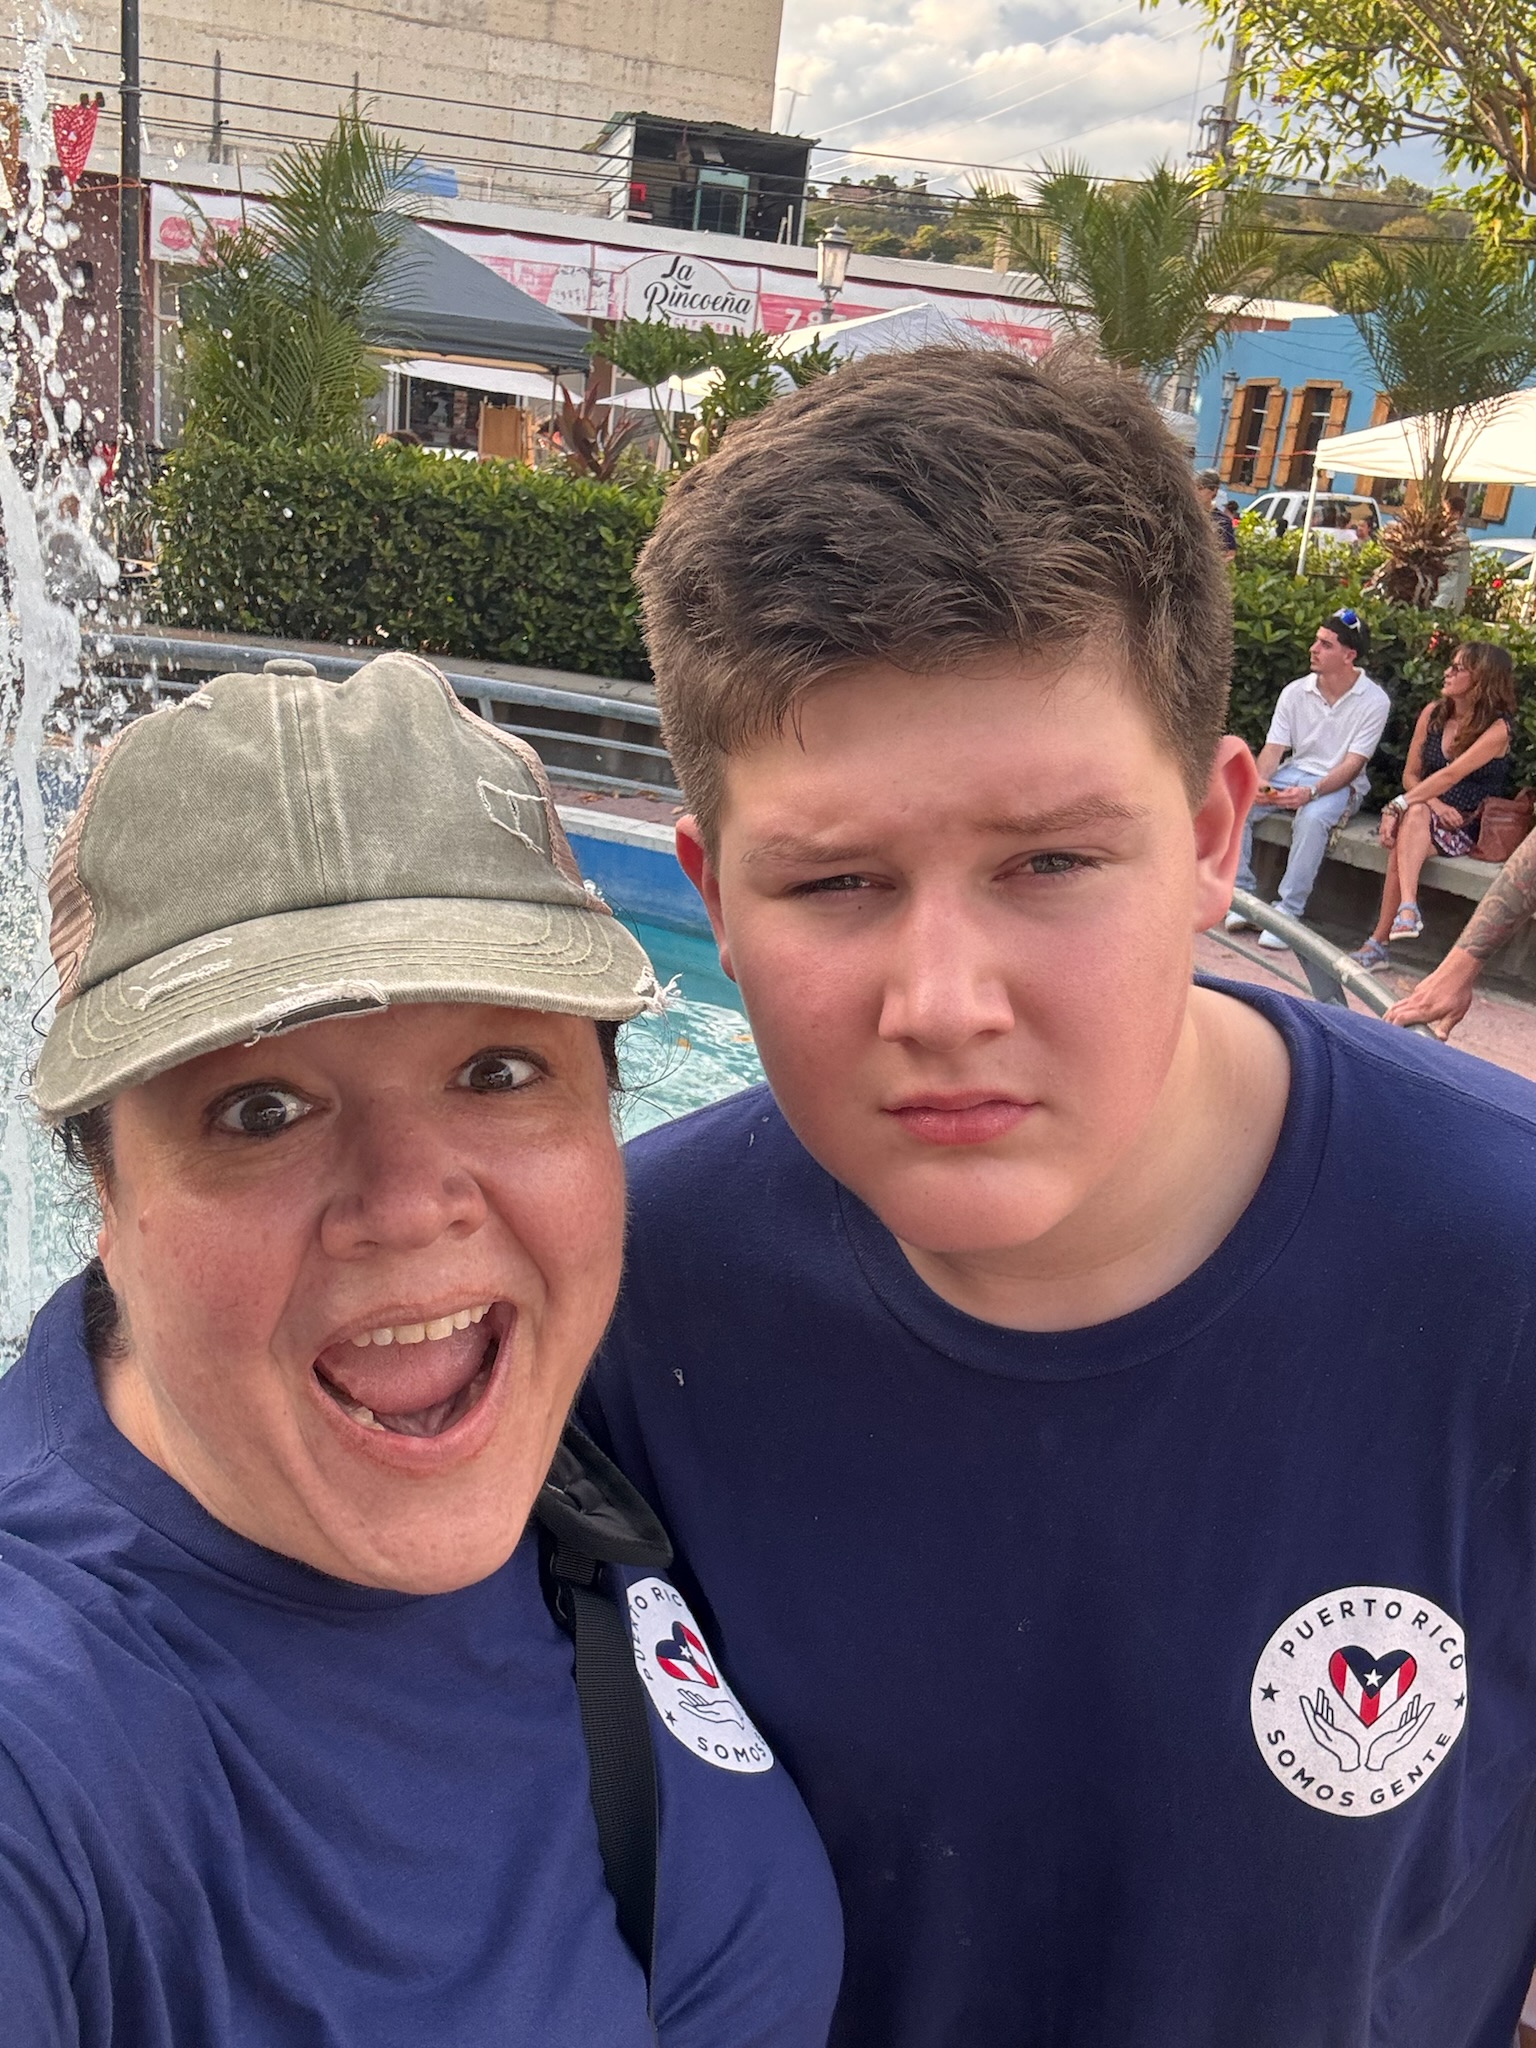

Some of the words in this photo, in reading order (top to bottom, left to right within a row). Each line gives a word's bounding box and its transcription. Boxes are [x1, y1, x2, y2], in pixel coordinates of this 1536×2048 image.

[661, 255, 695, 290] La
[644, 281, 753, 317] Rincoeña
[650, 1586, 682, 1607] RIC
[1280, 1598, 1402, 1658] PUERTO
[1411, 1609, 1465, 1670] RICO
[697, 1736, 767, 1763] SOMOS
[1267, 1729, 1355, 1807] SOMOS
[1370, 1733, 1451, 1805] GENTE
